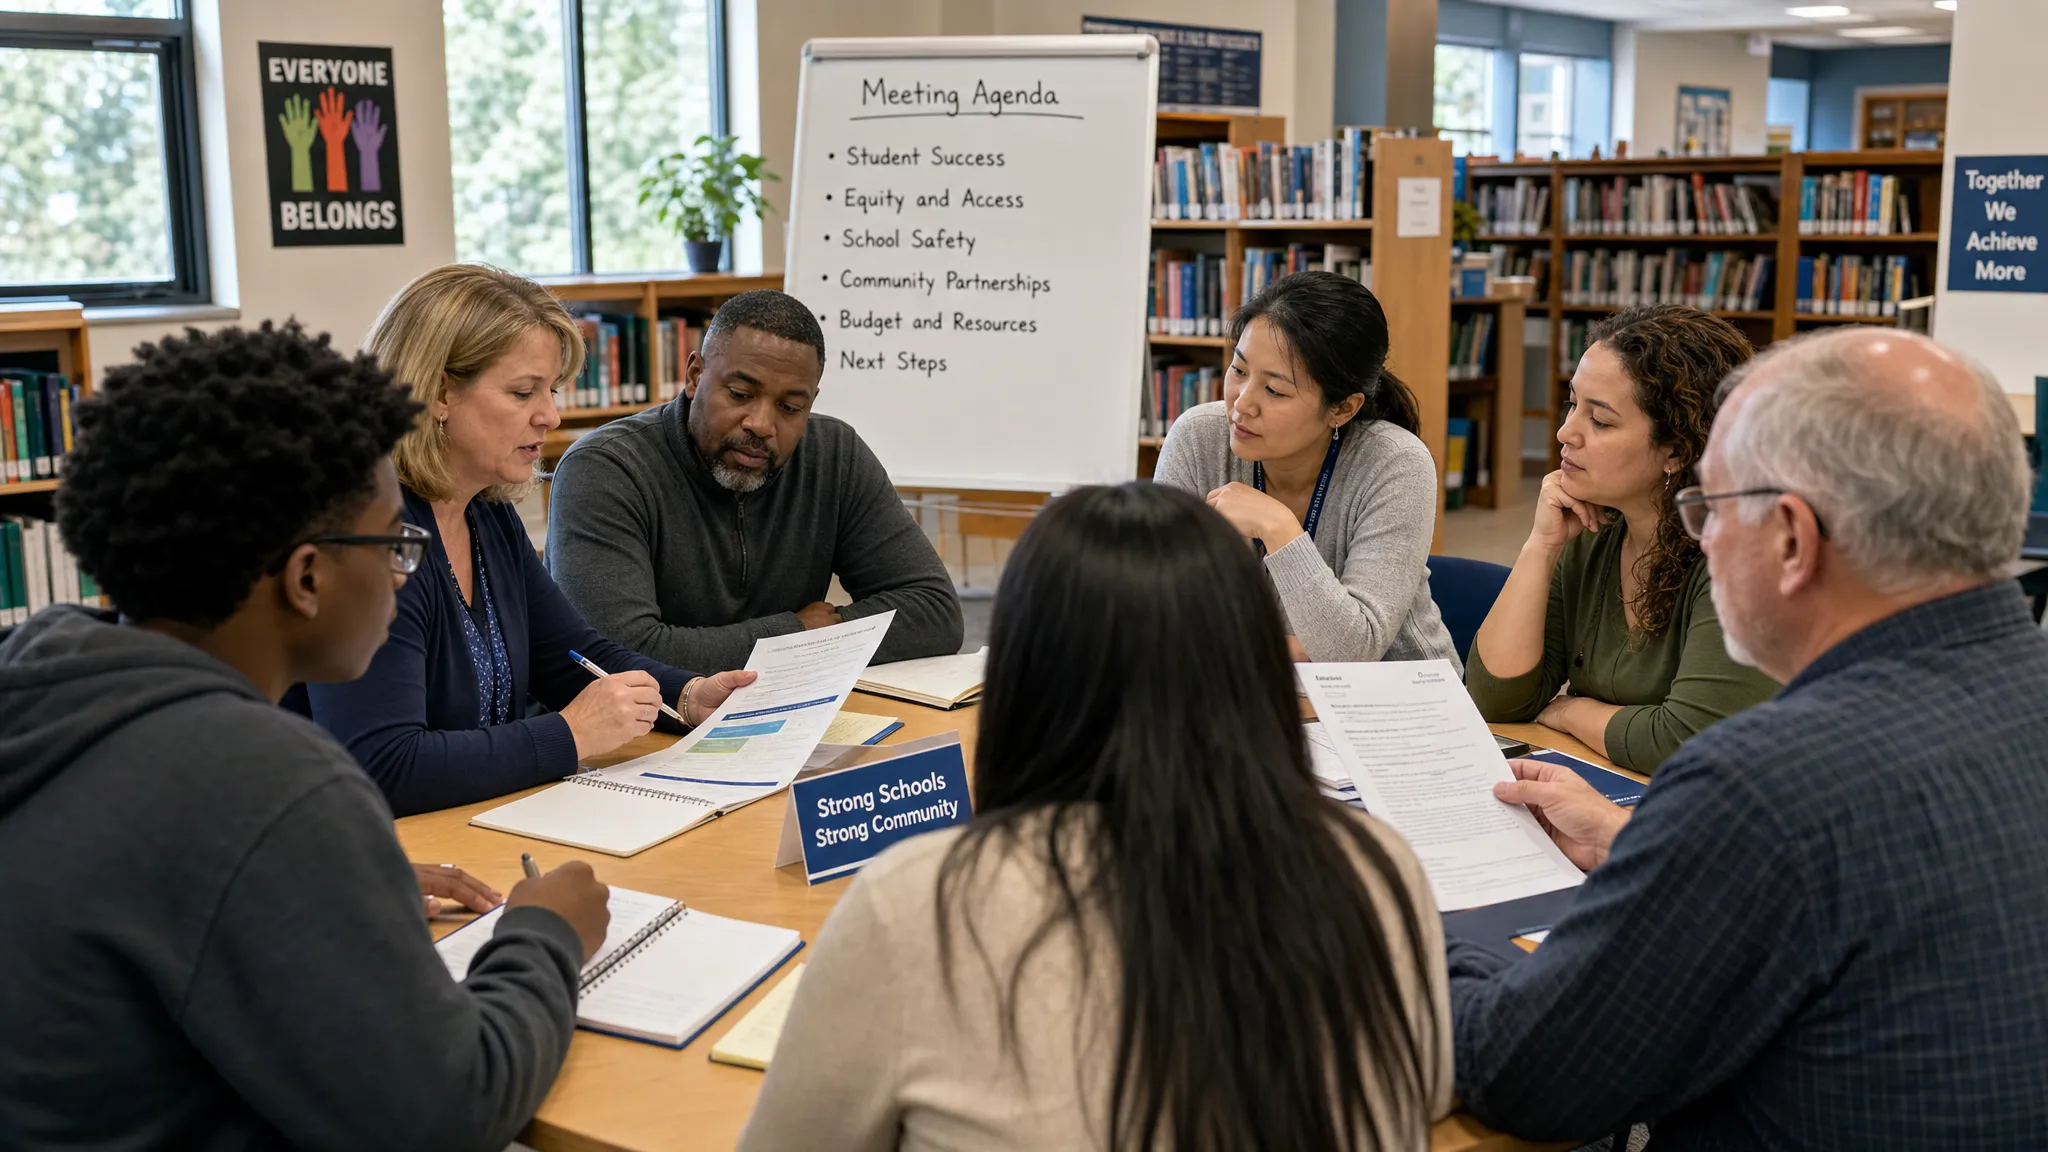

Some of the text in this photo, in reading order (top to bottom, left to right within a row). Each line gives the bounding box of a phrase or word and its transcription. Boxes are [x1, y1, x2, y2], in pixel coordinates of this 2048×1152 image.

[268, 57, 388, 86] EVERYONE
[862, 78, 1059, 116] Meeting Agenda
[847, 146, 1005, 167] Student Success
[1965, 169, 2044, 195] Together
[844, 188, 1024, 214] Equity and Access
[1985, 201, 2017, 221] We
[280, 200, 397, 230] BELONGS
[843, 229, 976, 255] School Safety
[1966, 230, 2038, 251] Achieve
[1975, 260, 2027, 281] More
[840, 270, 1051, 298] Community Partnerships
[840, 310, 1037, 336] Budget and Resources
[840, 351, 947, 377] Next Steps
[817, 772, 947, 818] Strong Schools
[815, 799, 958, 848] Strong Community
